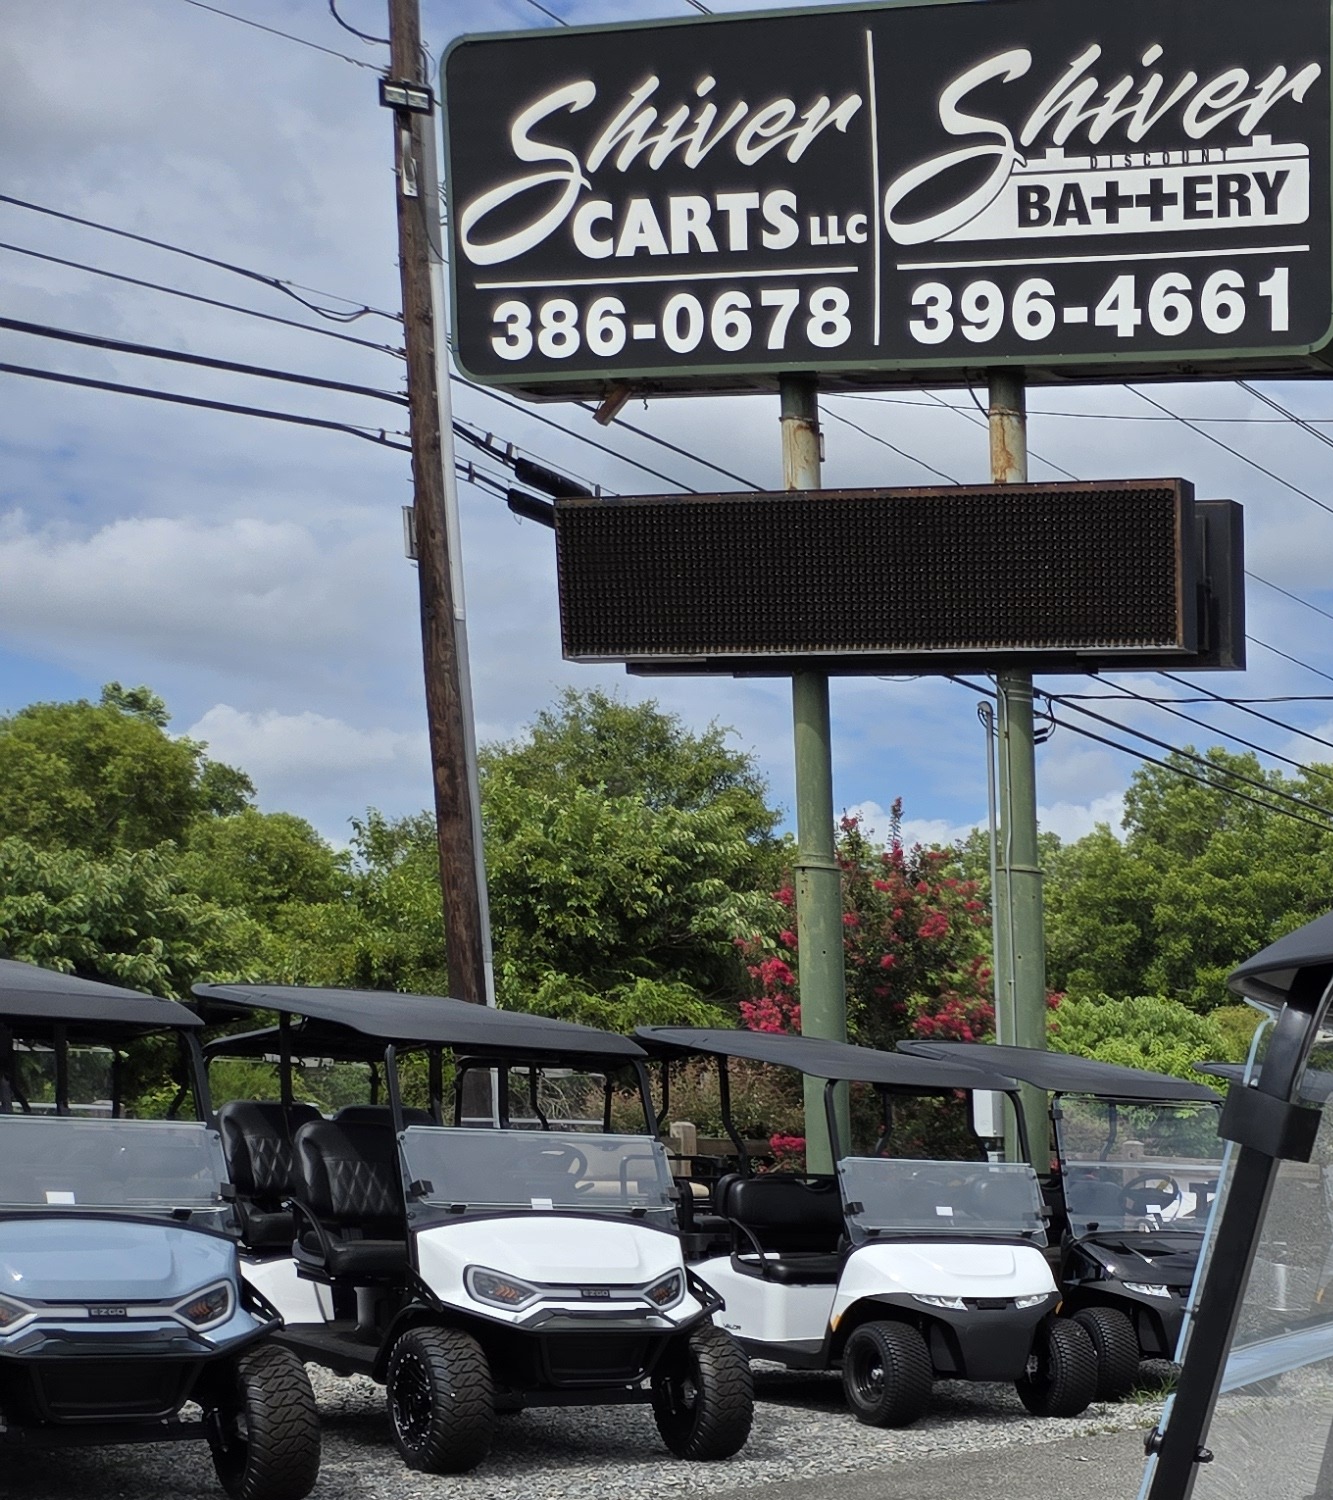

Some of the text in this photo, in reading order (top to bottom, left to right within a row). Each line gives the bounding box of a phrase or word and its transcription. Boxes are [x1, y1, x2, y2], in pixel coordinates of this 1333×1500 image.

[460, 75, 863, 266] Shiver
[884, 43, 1321, 245] Shiver
[1089, 147, 1229, 170] DISCOUNT
[573, 189, 868, 259] CARTS LLC
[491, 286, 852, 360] 386-0678
[909, 266, 1290, 345] 396-4661
[90, 1308, 125, 1316] EZGO
